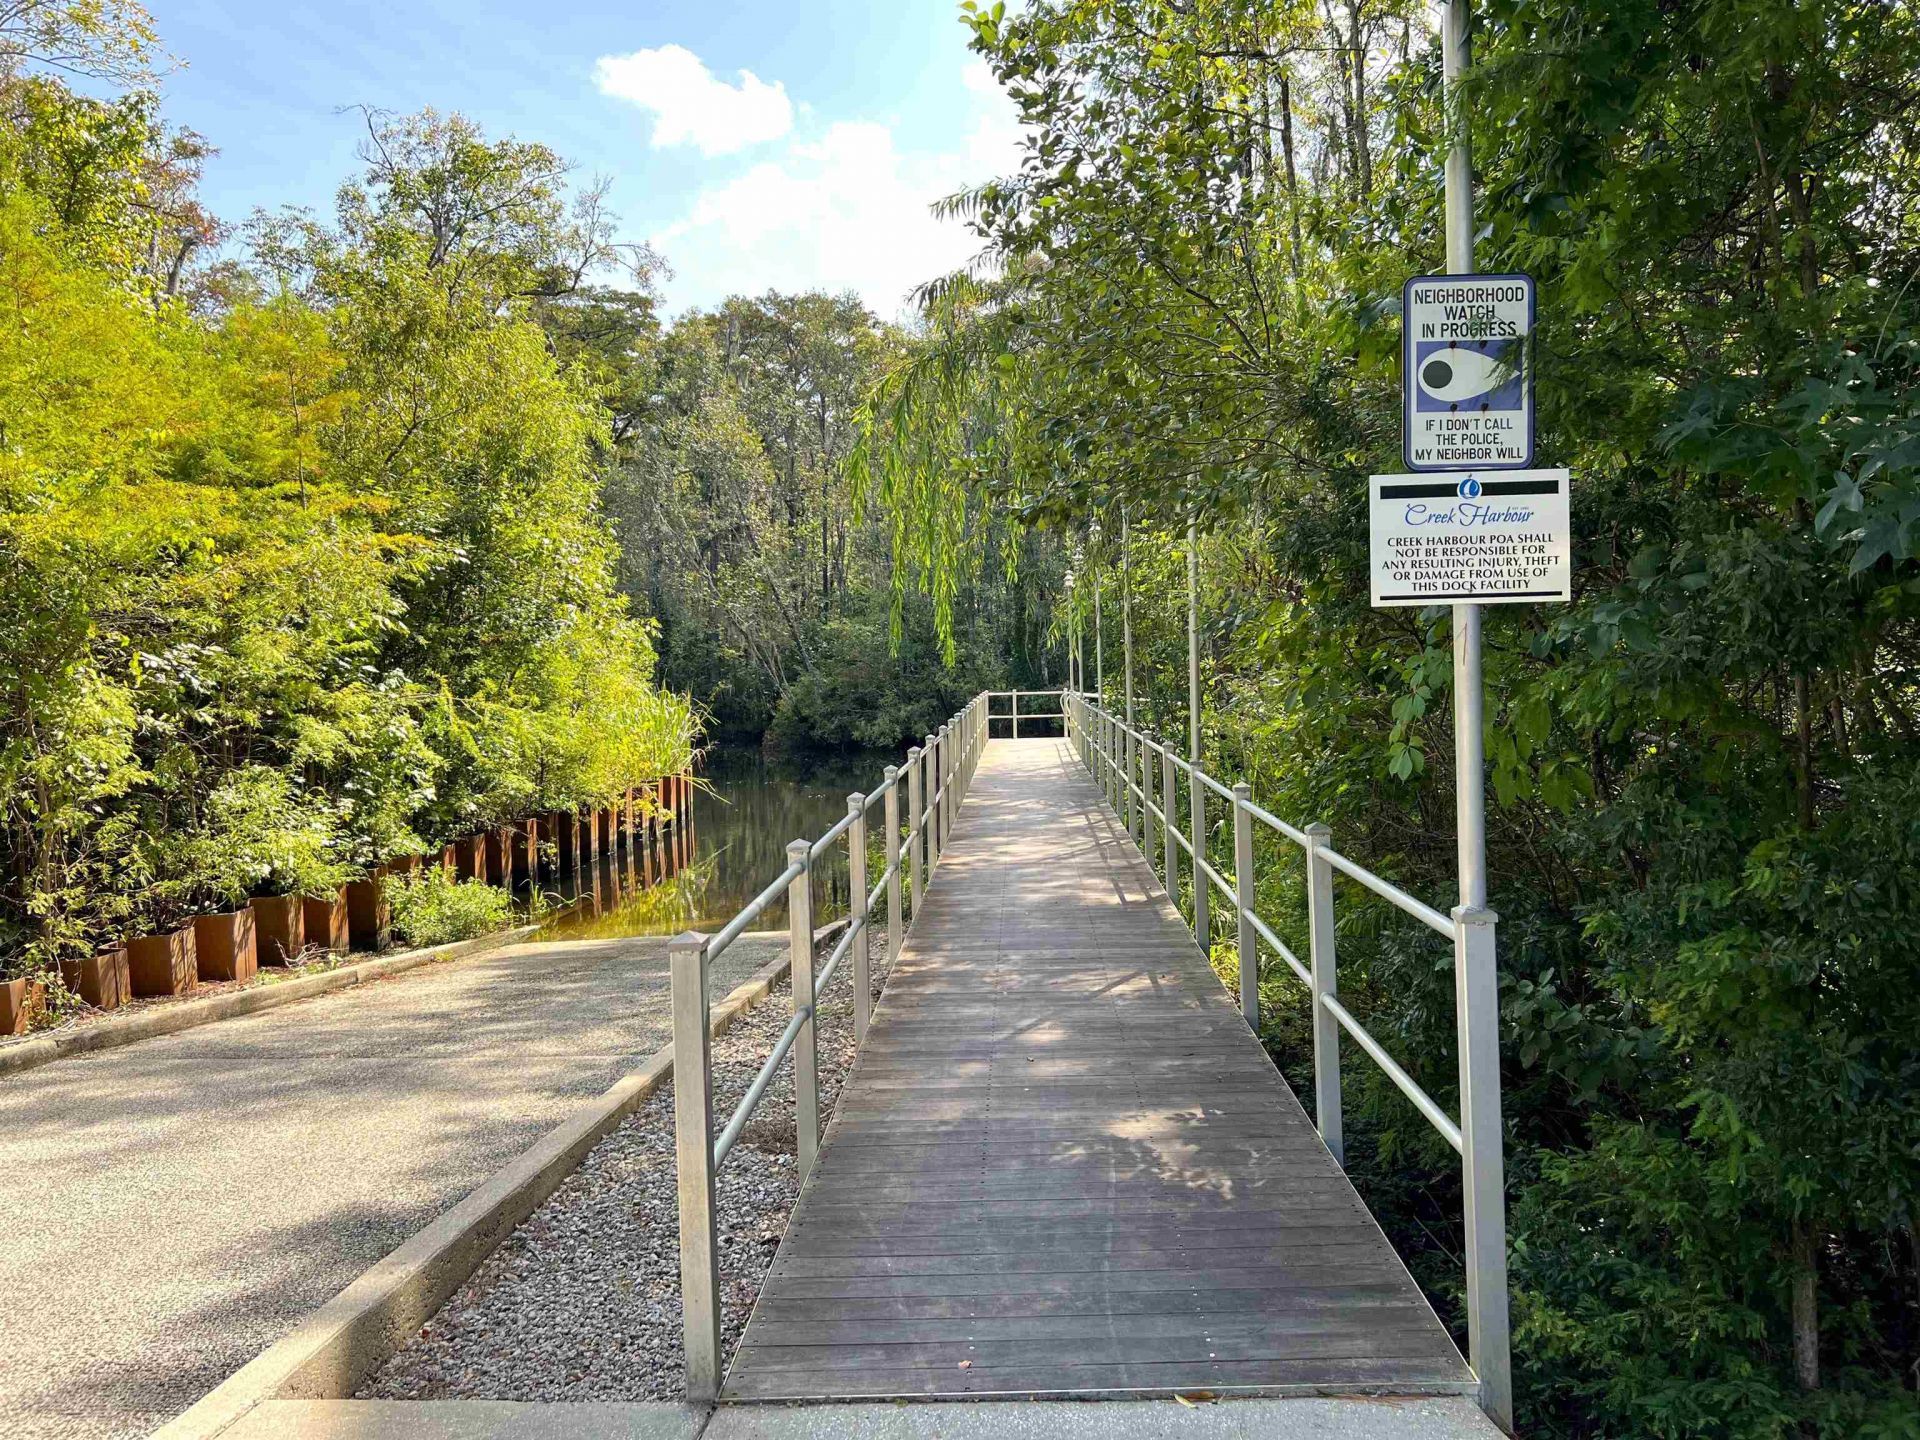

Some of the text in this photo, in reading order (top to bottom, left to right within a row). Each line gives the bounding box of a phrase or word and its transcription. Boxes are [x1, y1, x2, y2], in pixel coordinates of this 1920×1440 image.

[1414, 287, 1524, 304] NEIGHBORHOOD
[1444, 305, 1495, 321] WATCH
[1422, 321, 1517, 338] IN PROGRESS
[1426, 418, 1513, 431] IF I DON'T CALL
[1436, 433, 1503, 446] THE POLICE,
[1415, 447, 1523, 460] MY NEIGHBOR WILL
[1405, 502, 1534, 526] Creek Harbour
[1388, 533, 1554, 547] CREEK HARBOUR POA SHALL
[1395, 545, 1545, 558] NOT BE RESPONSIBLE FOR
[1382, 556, 1560, 570] ANY RESULTING INJURY, THEFT
[1393, 567, 1549, 581] OR DAMAGE FROM USE OF
[1412, 580, 1530, 591] THIS DOCK FACILITY
